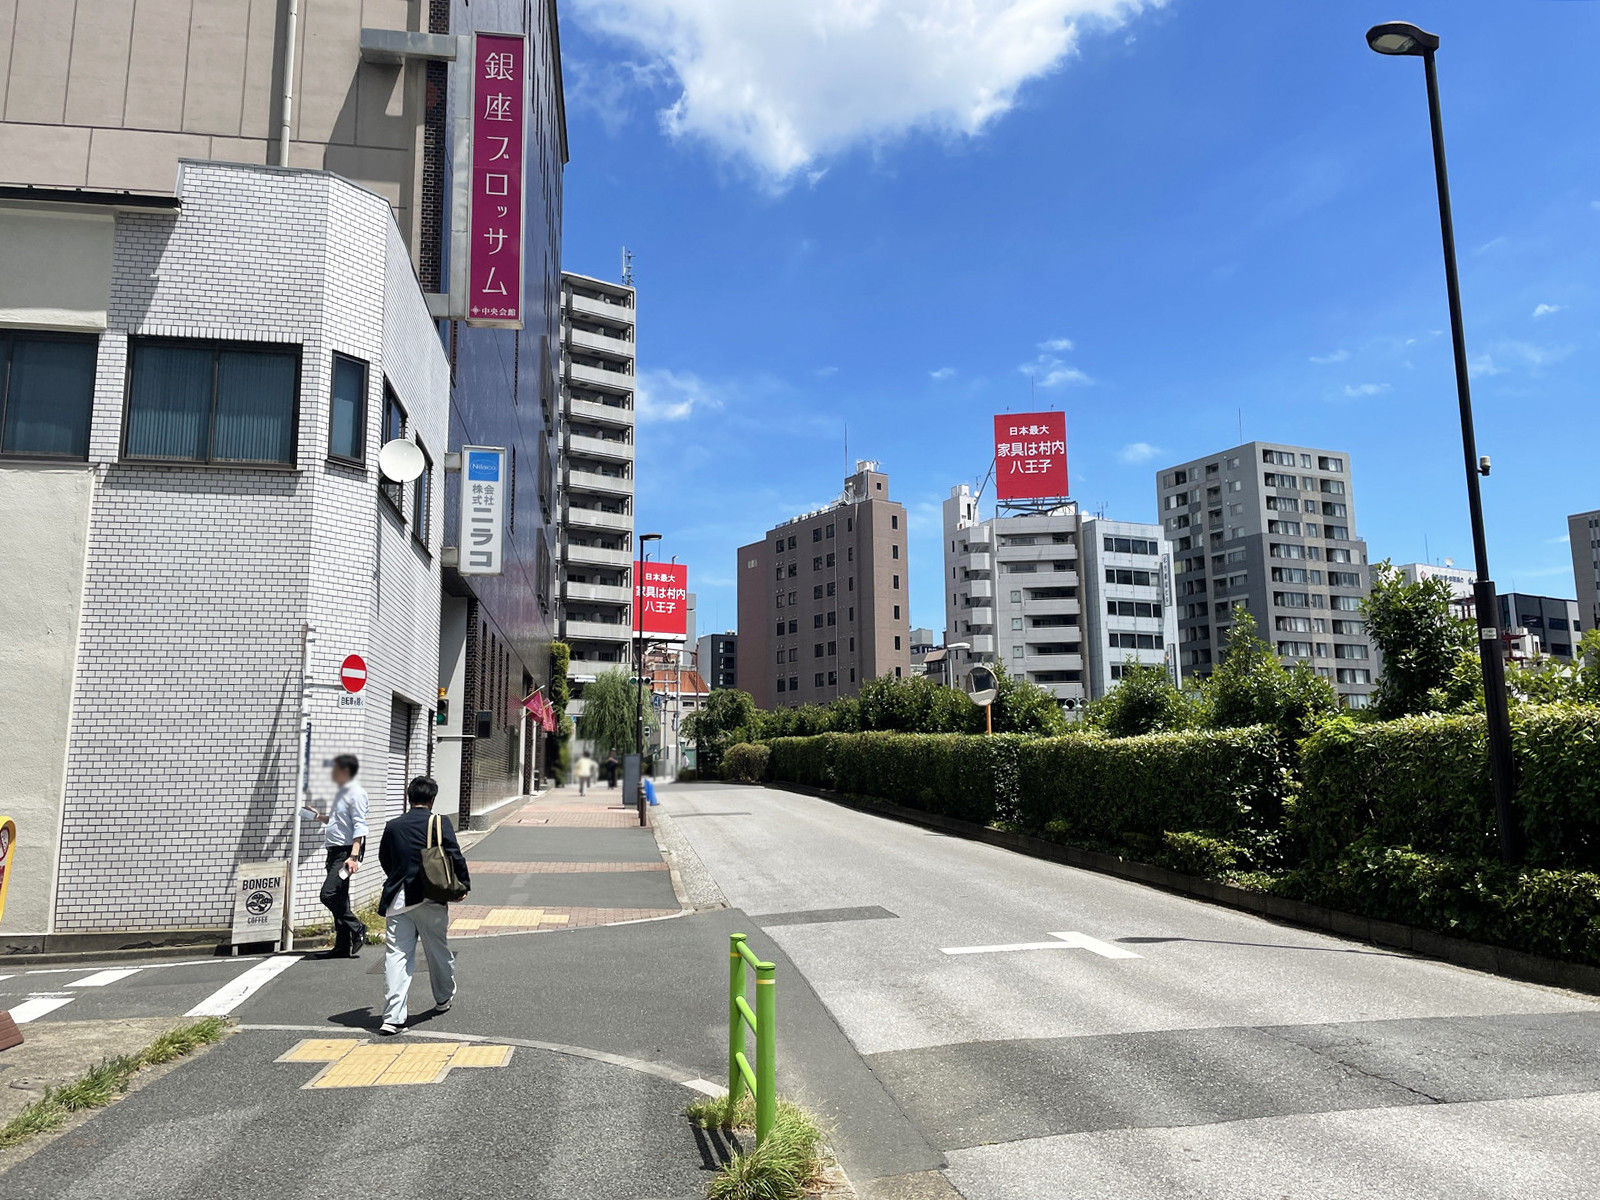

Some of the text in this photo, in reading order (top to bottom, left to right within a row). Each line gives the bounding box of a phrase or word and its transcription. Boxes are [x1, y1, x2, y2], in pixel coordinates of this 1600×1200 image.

[482, 52, 514, 295] 銀座ブロッサム
[481, 307, 516, 317] 中央会館
[1009, 425, 1050, 436] 日本最大
[997, 440, 1065, 457] 家具は村内
[472, 463, 496, 471] Nilaco
[1010, 459, 1052, 474] 八王子
[469, 507, 494, 567] ニラコ
[645, 573, 676, 582] 日本最大
[645, 601, 676, 614] 八王子
[242, 877, 281, 891] BONGEN
[247, 915, 269, 925] COFFEE
